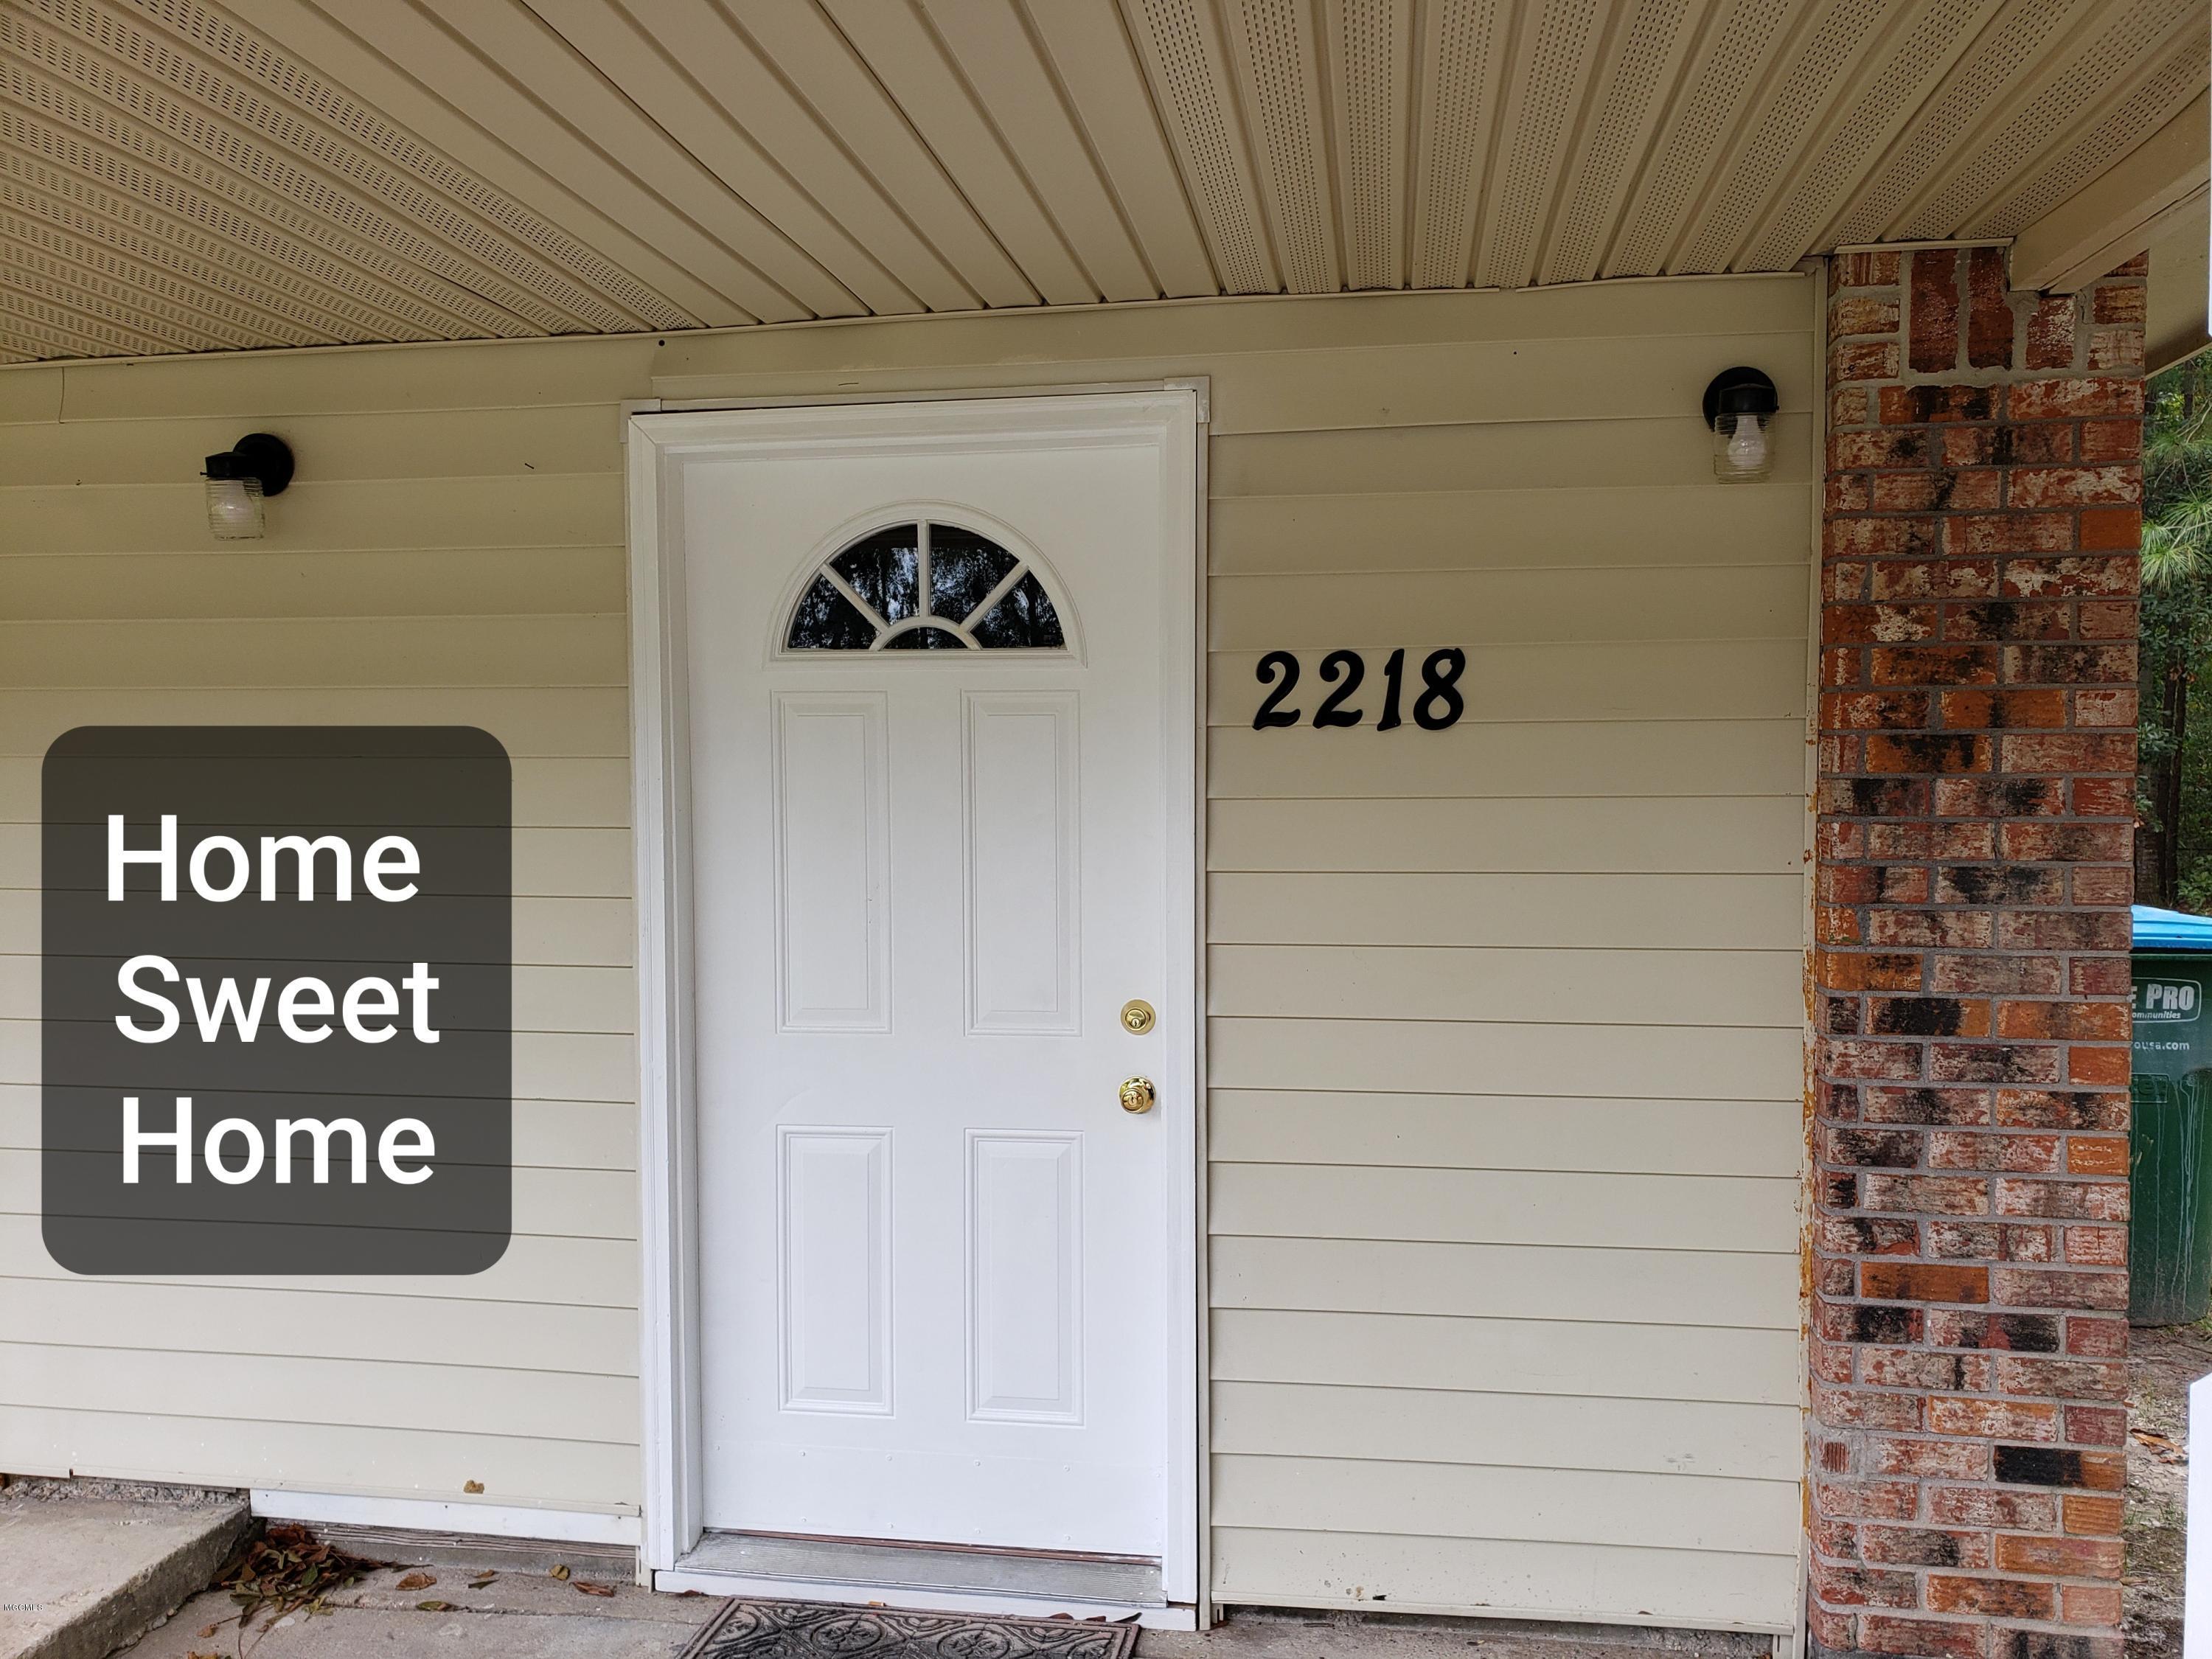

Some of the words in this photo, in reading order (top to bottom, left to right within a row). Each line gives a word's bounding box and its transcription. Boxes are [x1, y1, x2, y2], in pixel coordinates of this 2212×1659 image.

[1251, 647, 1467, 732] 2218
[2146, 984, 2195, 1011] PRO
[2131, 1010, 2181, 1020] ommunities
[2132, 1041, 2190, 1050] ousa.com
